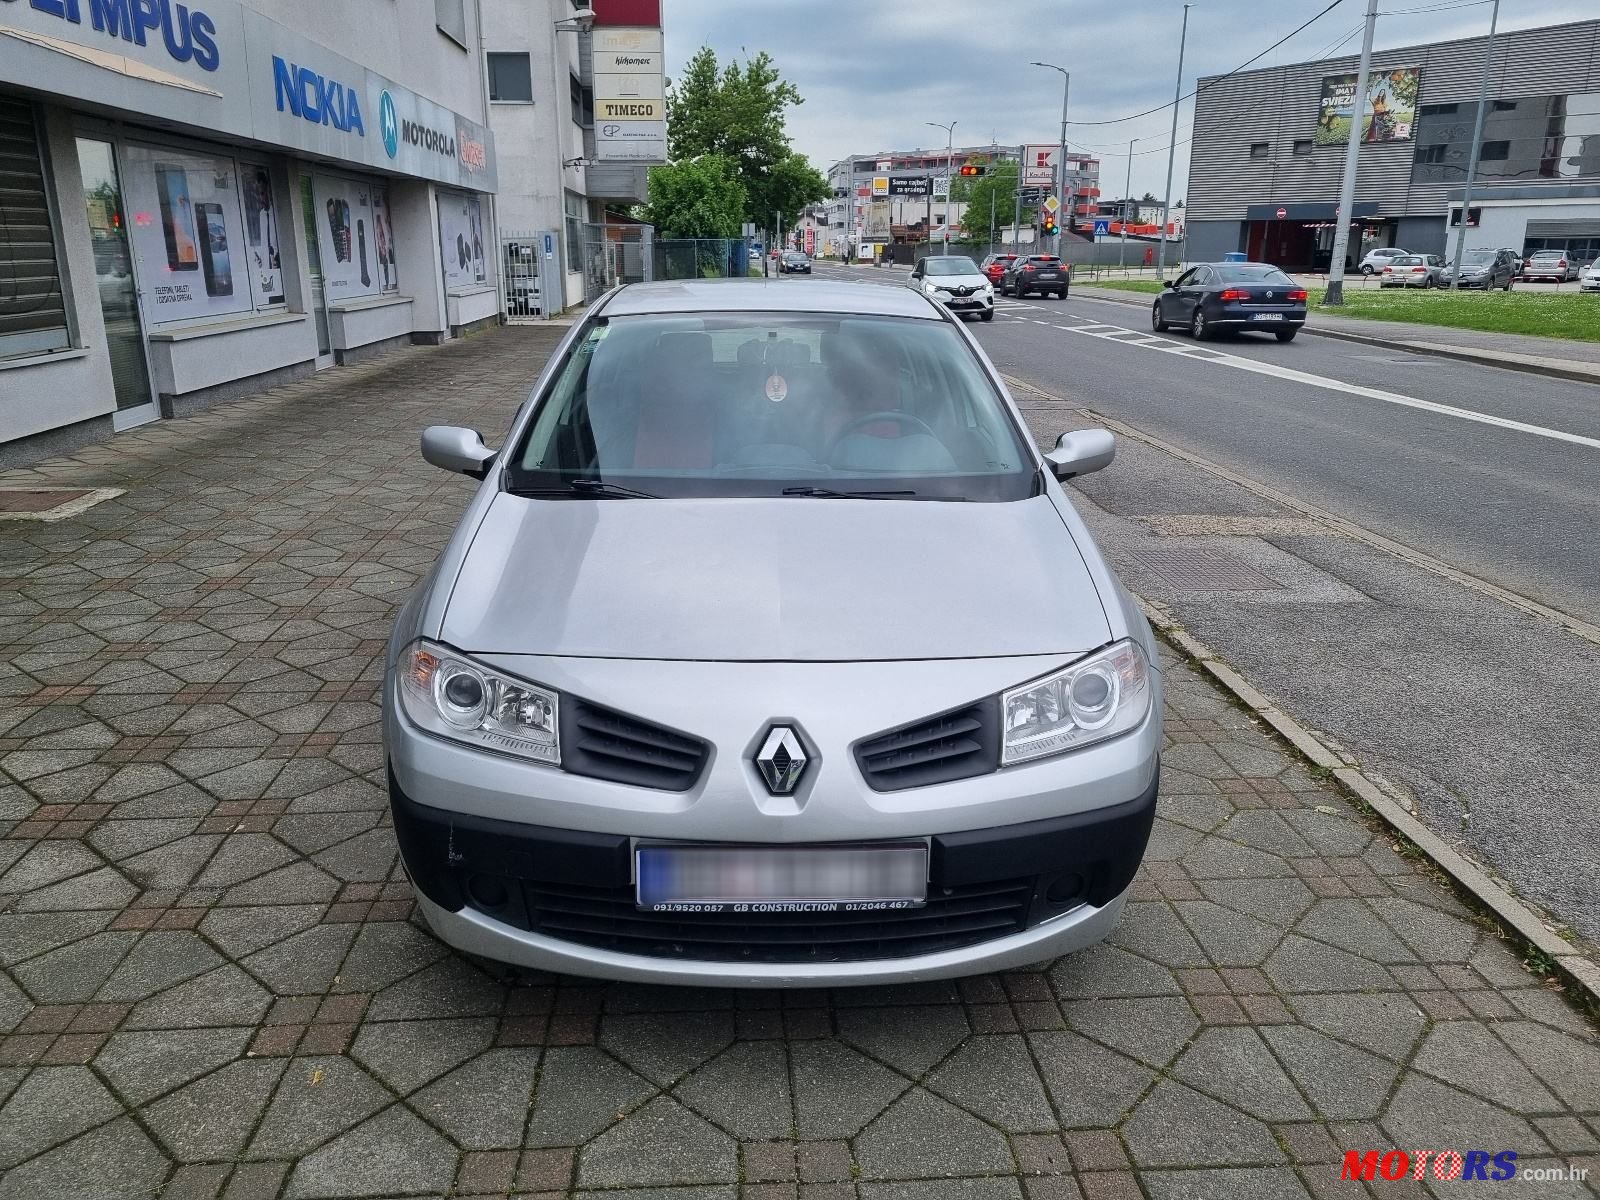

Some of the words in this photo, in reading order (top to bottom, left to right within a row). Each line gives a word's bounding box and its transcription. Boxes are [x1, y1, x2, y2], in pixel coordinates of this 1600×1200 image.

[615, 56, 651, 66] kirkomerc
[272, 54, 365, 137] NOKIA
[605, 104, 653, 116] TIMECO
[402, 118, 456, 159] MOTOROLA
[908, 179, 928, 187] najbolj
[653, 903, 702, 912] 091/9520
[704, 904, 724, 912] 057
[733, 903, 749, 912] GB
[752, 903, 838, 912] CONSTRUCTION
[845, 902, 887, 911] 01/2046
[889, 901, 909, 909] 467
